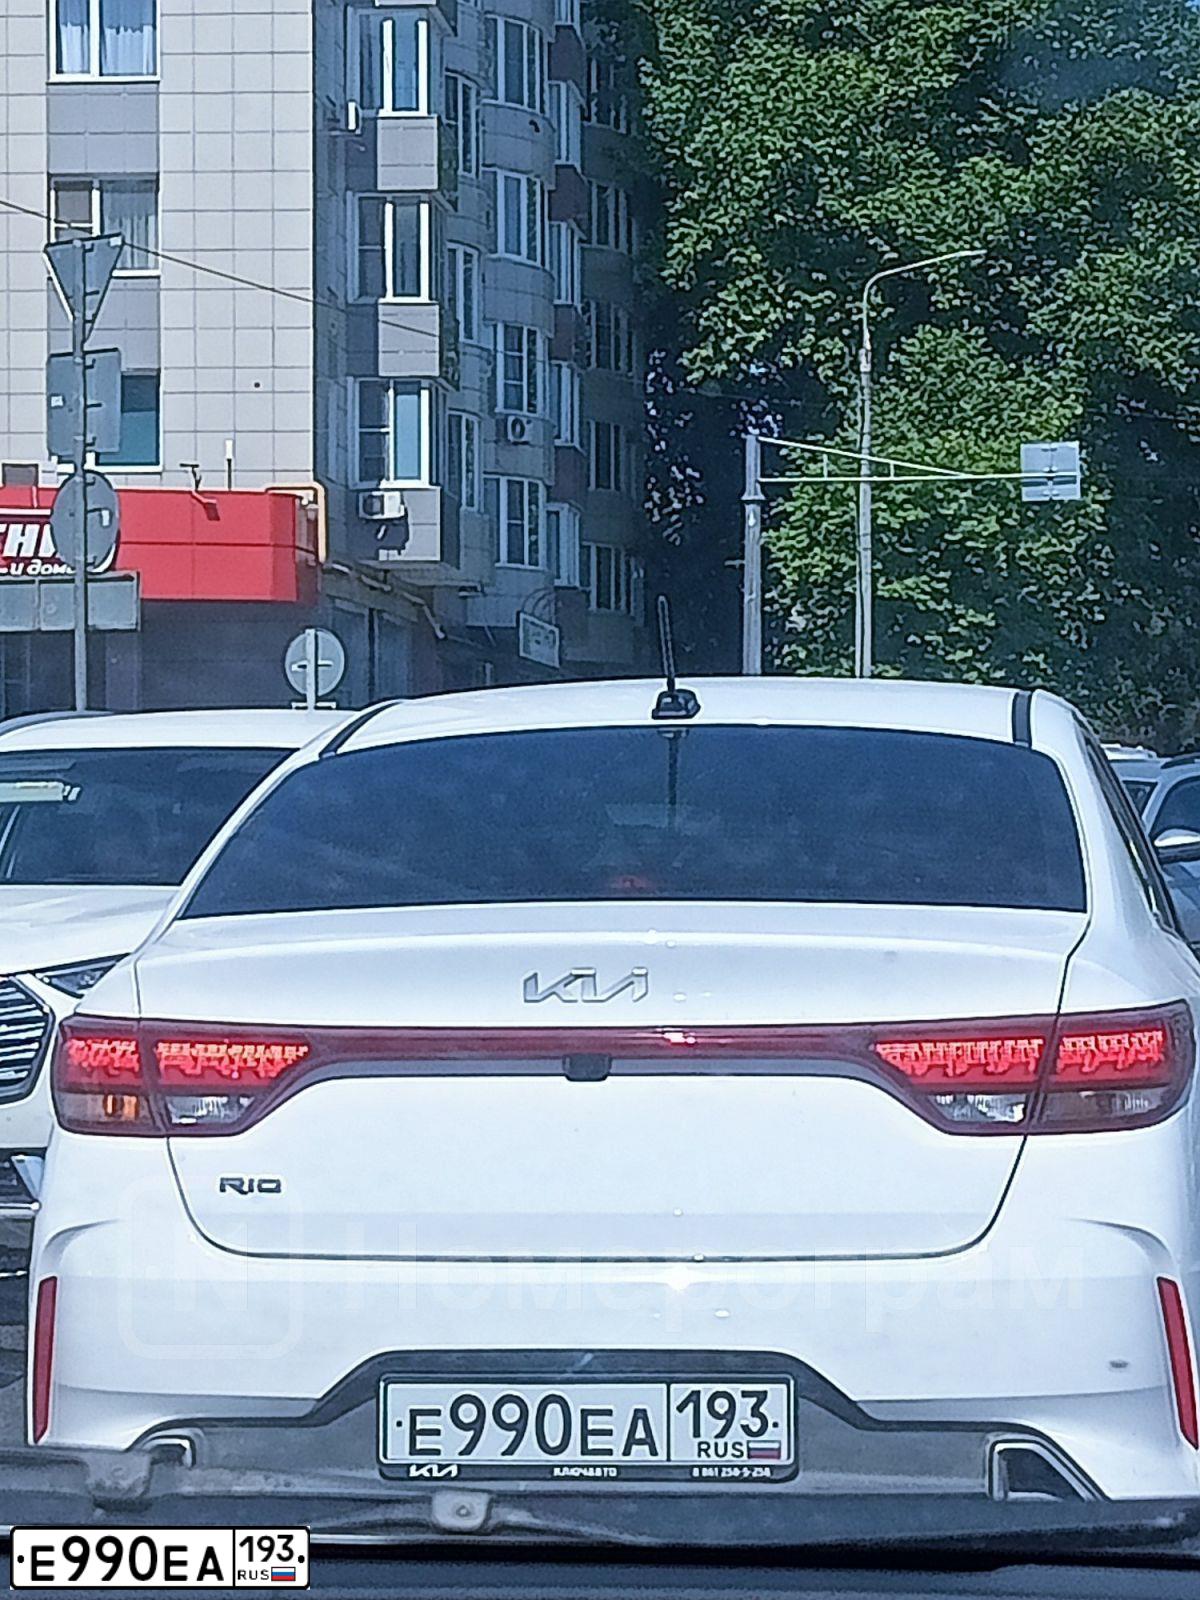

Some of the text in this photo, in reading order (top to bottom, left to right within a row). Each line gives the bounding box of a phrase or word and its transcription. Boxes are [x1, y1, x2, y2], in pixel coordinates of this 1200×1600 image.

[523, 966, 649, 1003] KIA
[219, 1177, 282, 1195] RIO
[676, 1389, 770, 1439] 193
[699, 1440, 745, 1459] RUS
[409, 1463, 458, 1478] KIA
